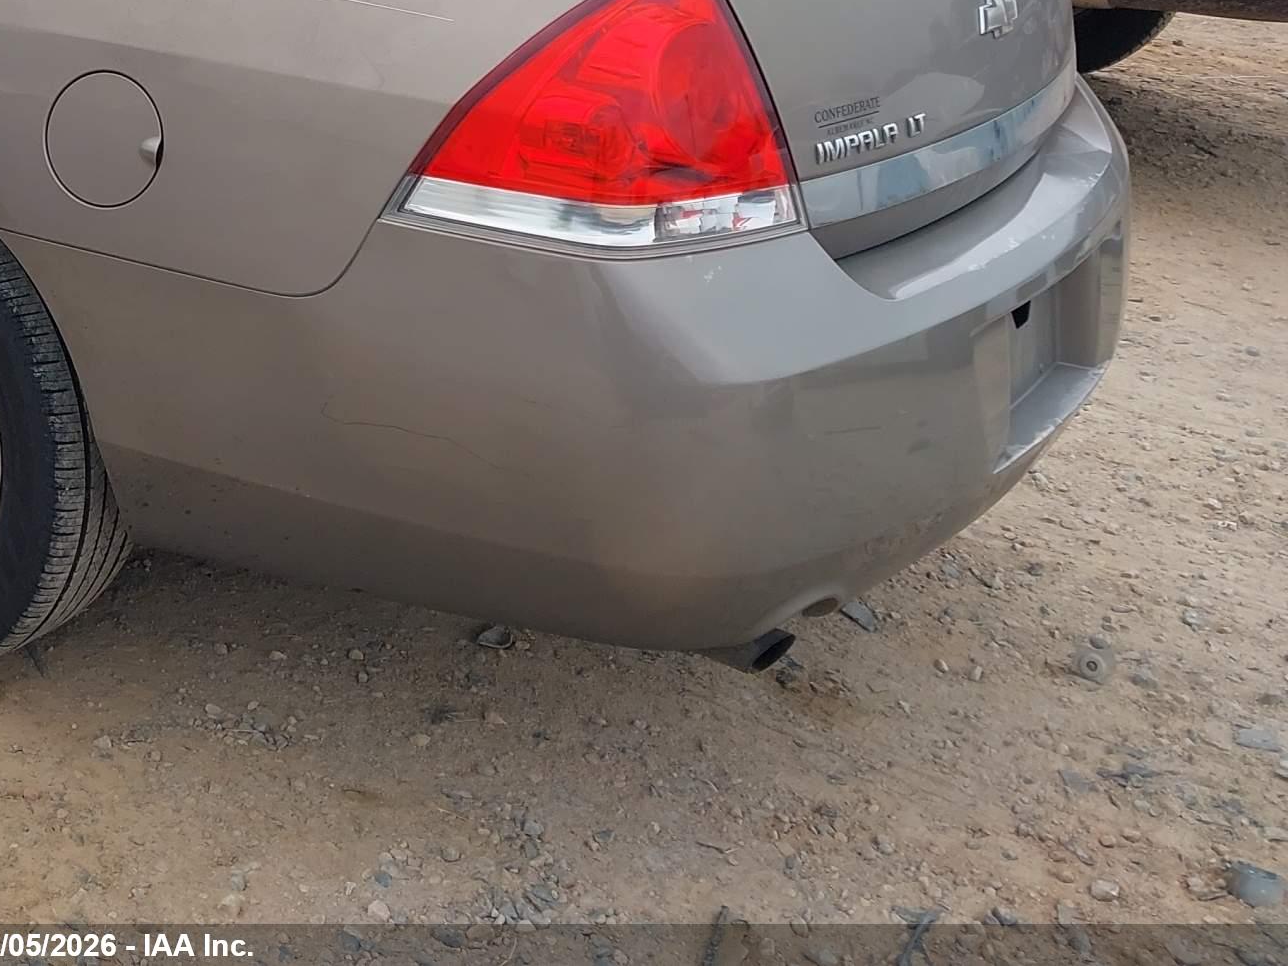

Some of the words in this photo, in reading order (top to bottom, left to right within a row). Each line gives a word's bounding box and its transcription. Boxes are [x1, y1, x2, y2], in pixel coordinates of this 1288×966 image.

[814, 96, 881, 124] CONFEDERATE
[815, 122, 899, 165] IMPALA
[906, 113, 927, 138] LT
